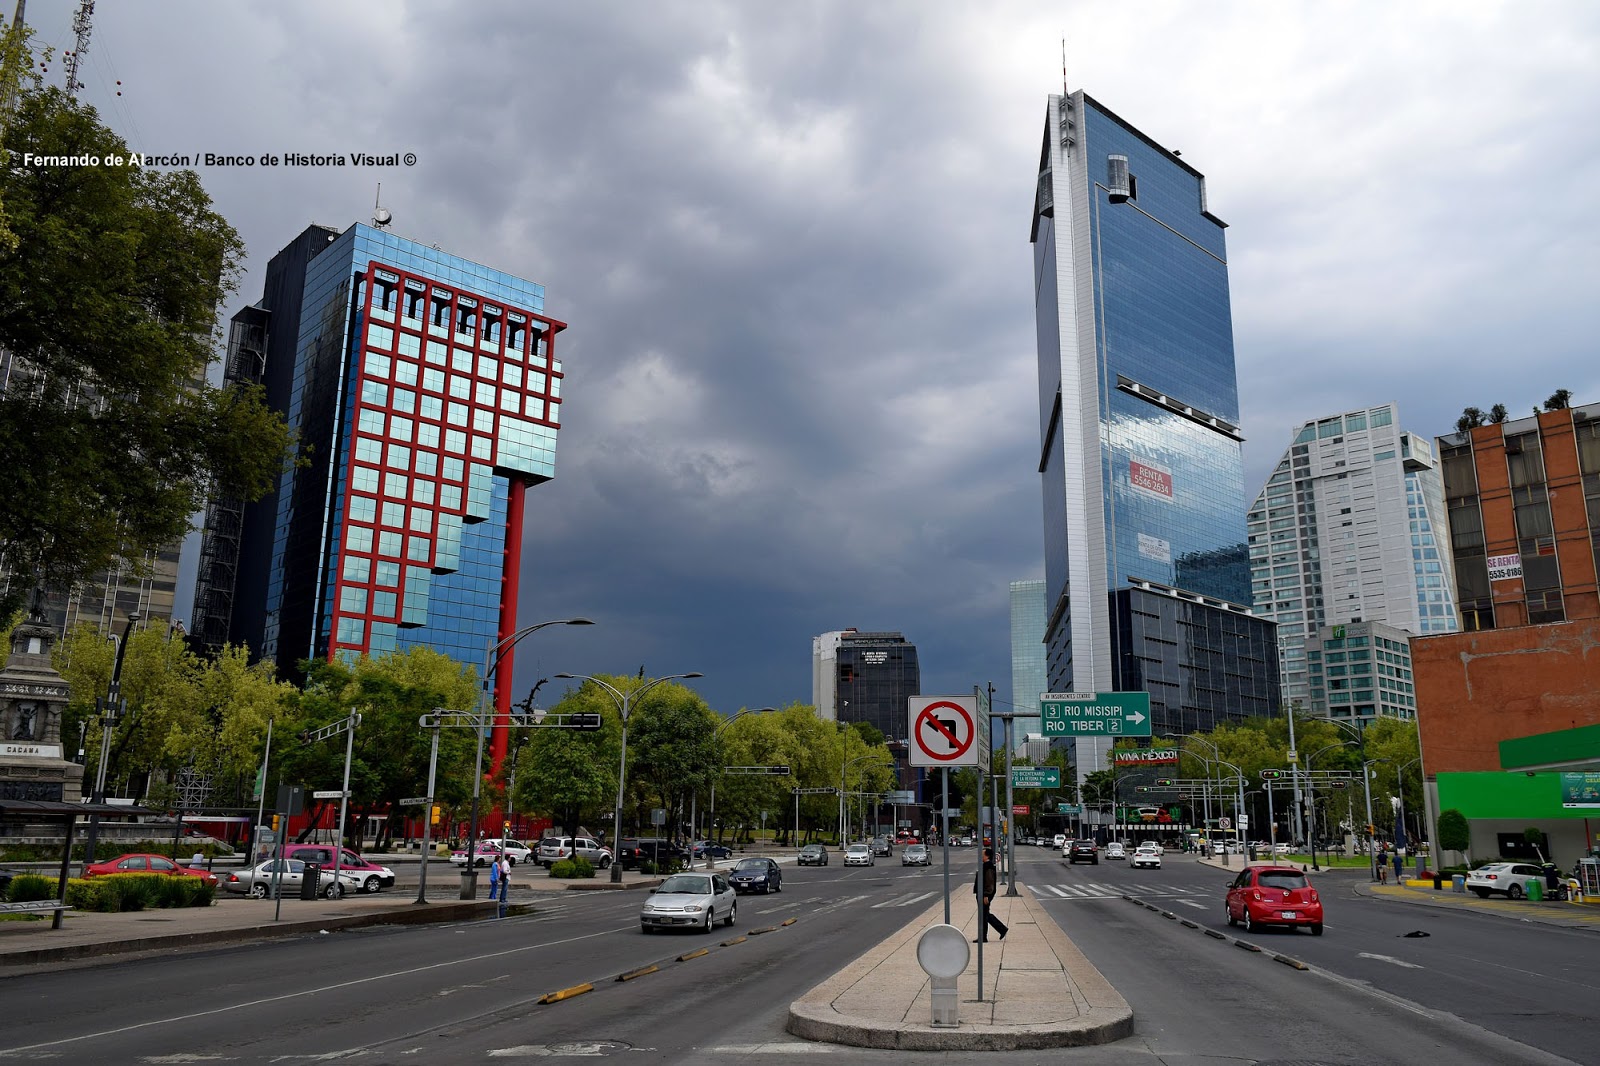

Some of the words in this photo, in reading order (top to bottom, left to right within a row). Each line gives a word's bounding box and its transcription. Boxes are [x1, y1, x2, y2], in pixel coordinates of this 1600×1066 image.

[1139, 466, 1163, 483] RENTA
[1134, 475, 1151, 488] 5546
[1152, 481, 1169, 494] 2634
[1488, 558, 1497, 568] SE
[1497, 556, 1520, 567] RENTA
[1489, 567, 1522, 579] 5535-0186
[1049, 707, 1056, 716] 3
[1064, 706, 1080, 716] RIO
[1084, 706, 1122, 716] MISISIPI
[1046, 721, 1065, 731] RIO
[1070, 721, 1104, 731] TIBER
[1111, 721, 1118, 730] 2
